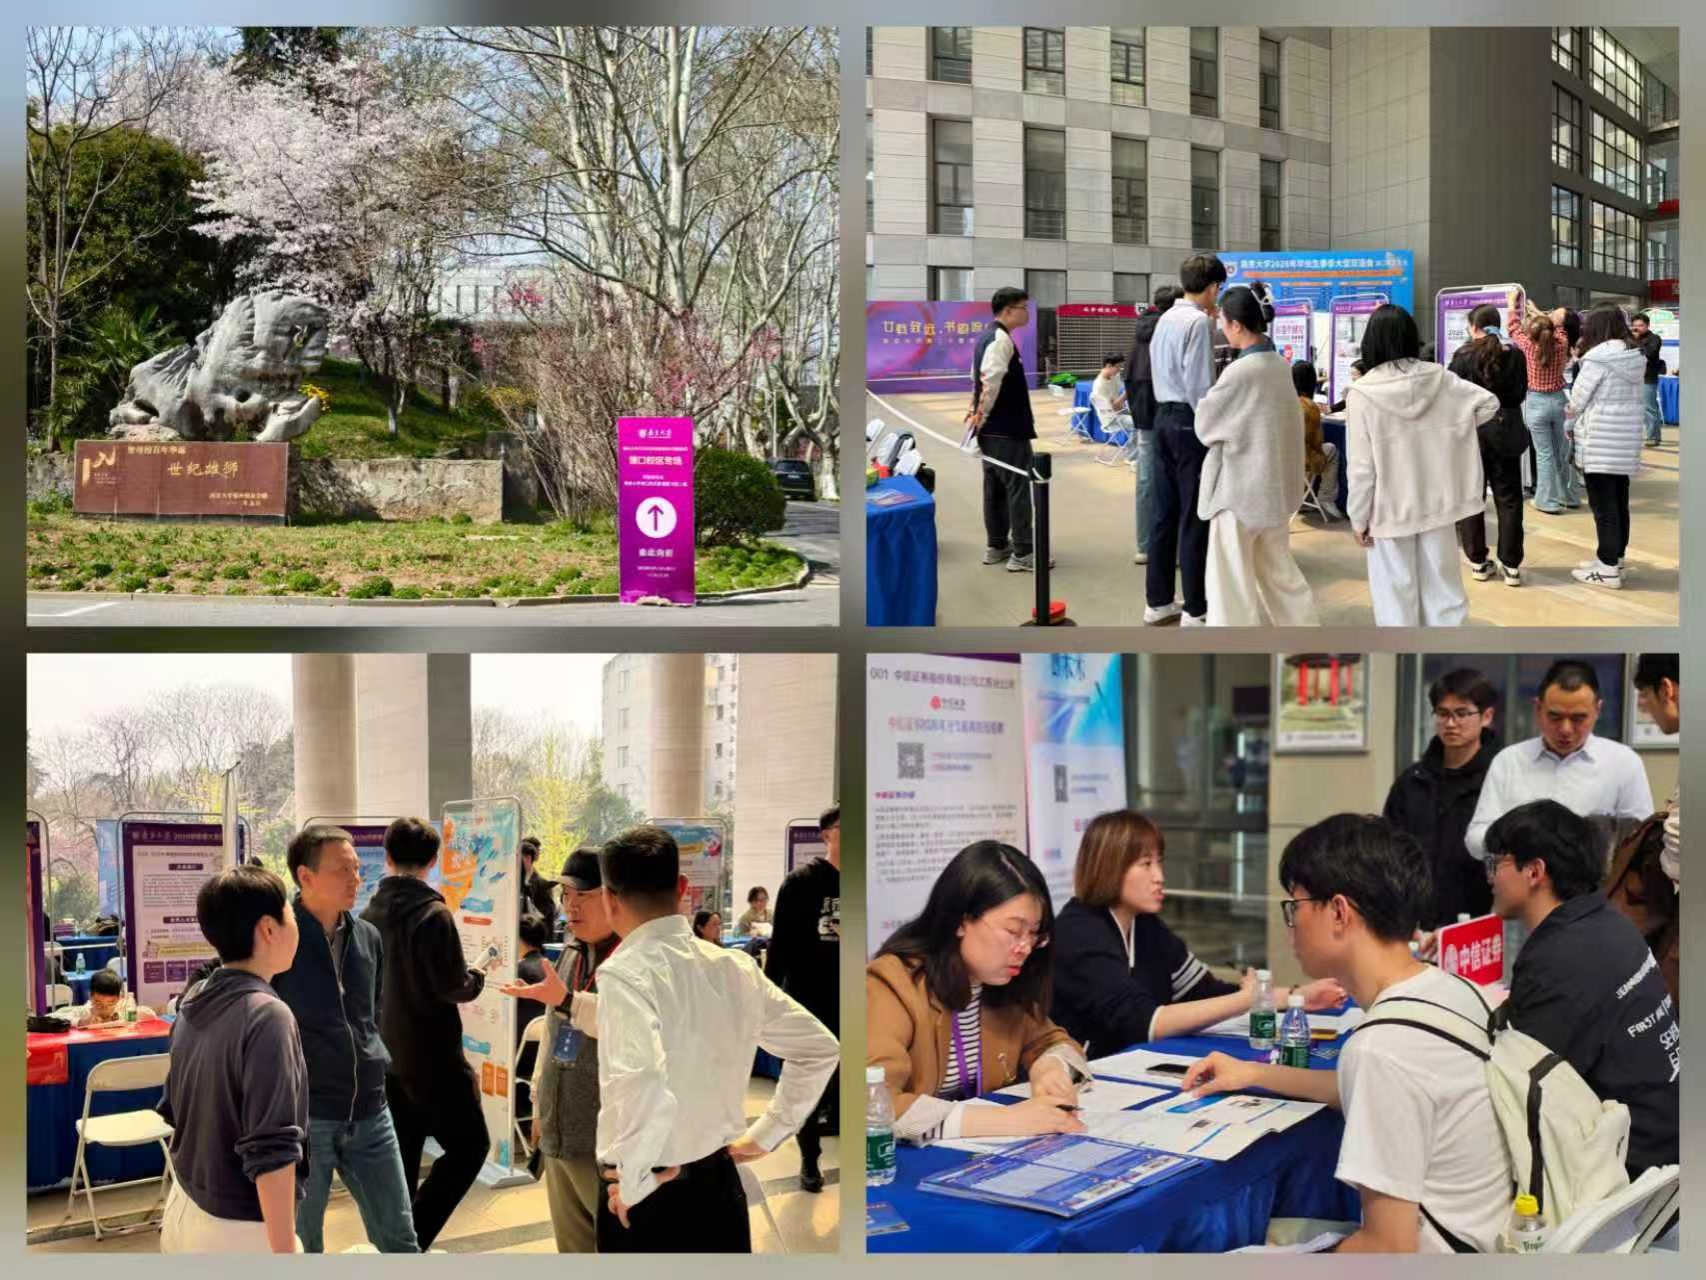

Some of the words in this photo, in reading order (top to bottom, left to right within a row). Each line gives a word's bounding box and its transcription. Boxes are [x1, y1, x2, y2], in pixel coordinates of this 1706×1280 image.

[168, 461, 239, 478] 世纪雄狮
[870, 667, 889, 680] 001
[1459, 934, 1503, 974] 中信证券
